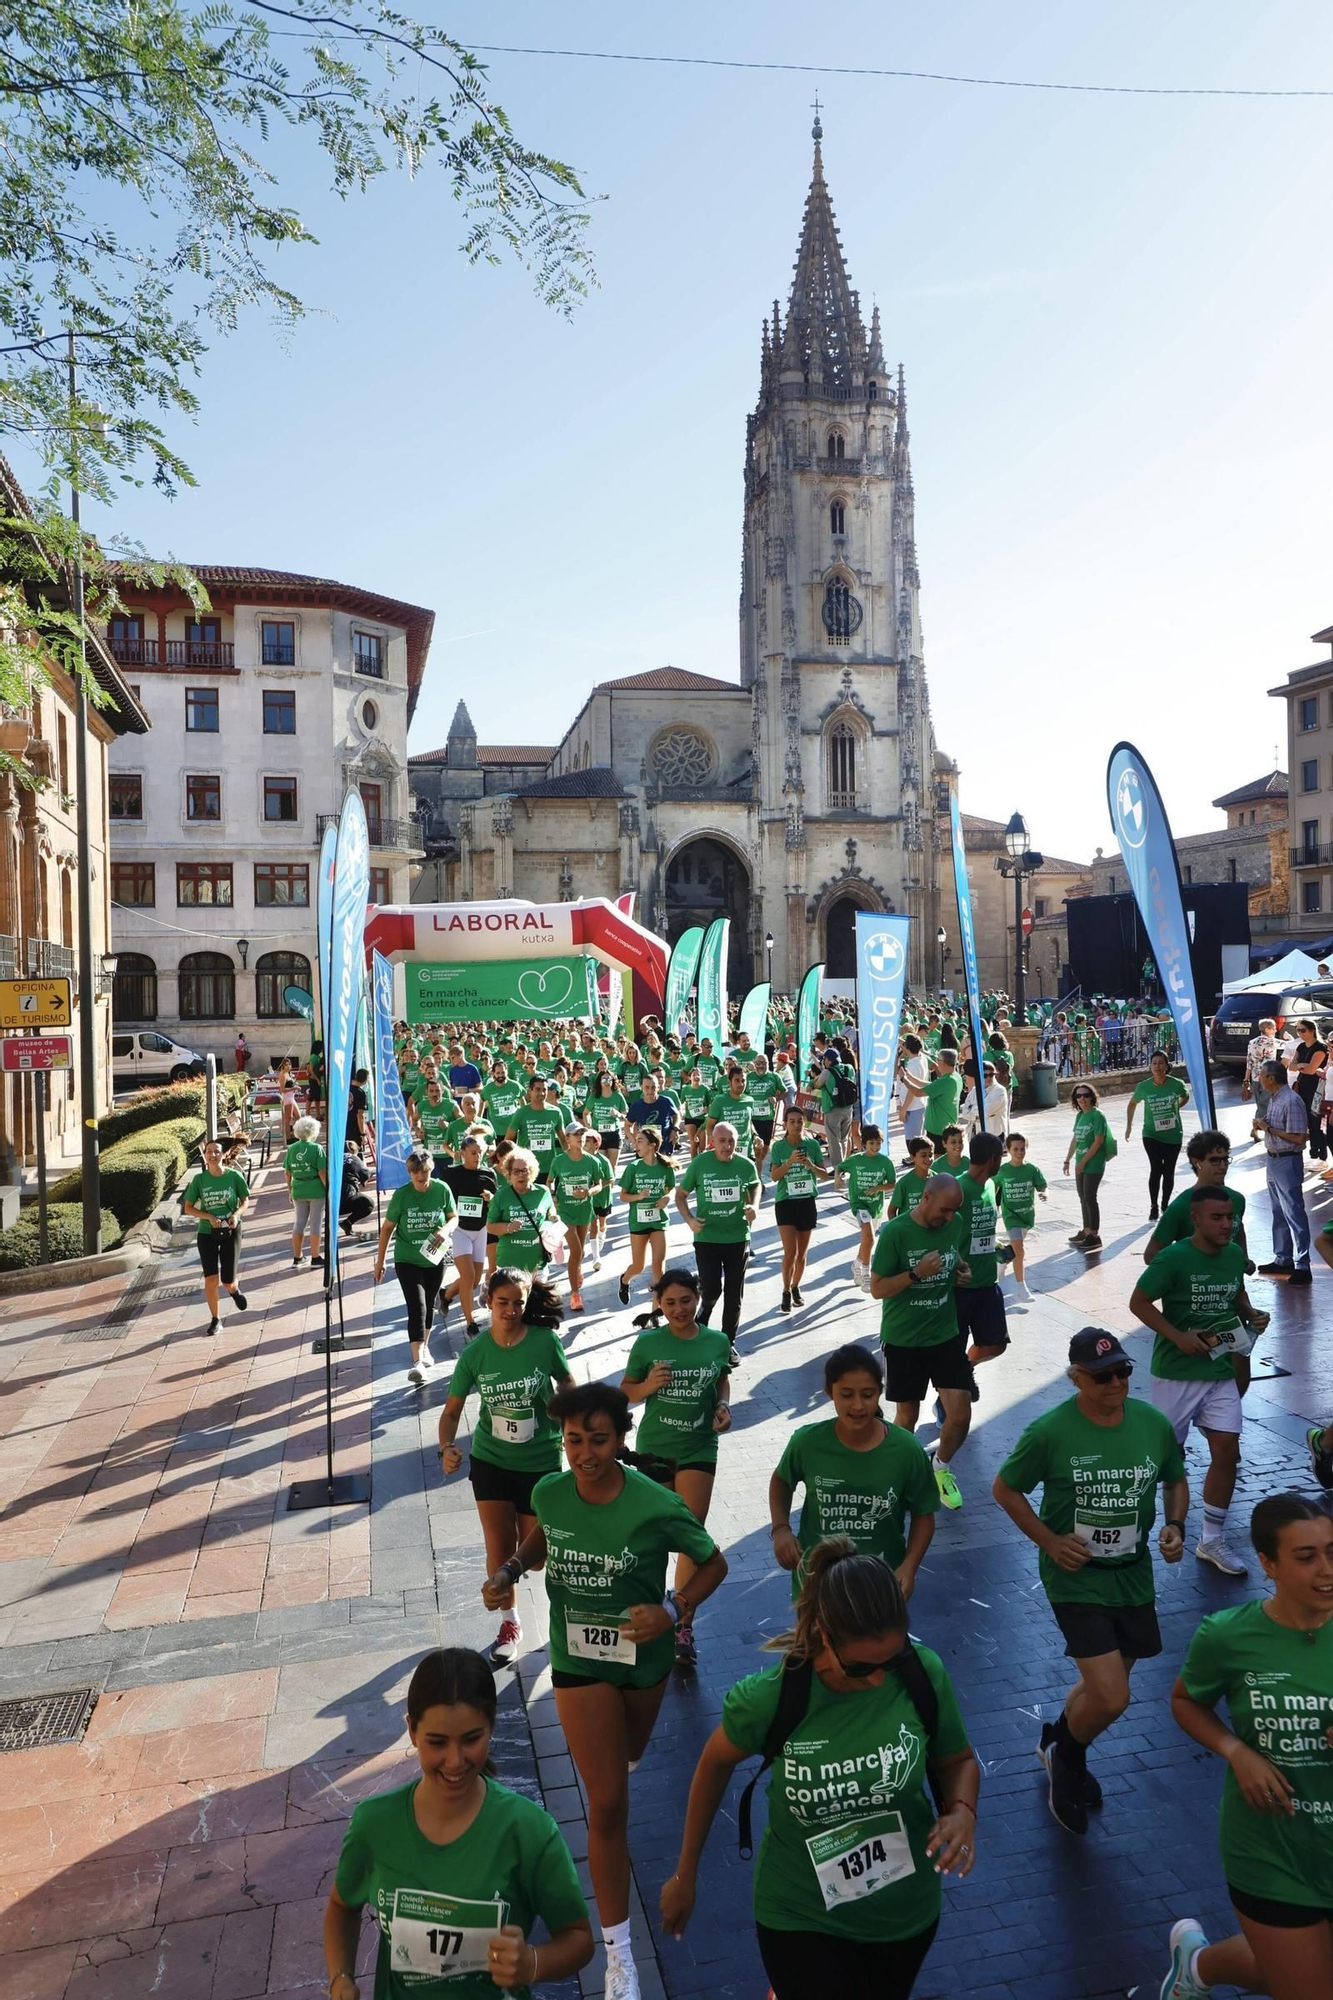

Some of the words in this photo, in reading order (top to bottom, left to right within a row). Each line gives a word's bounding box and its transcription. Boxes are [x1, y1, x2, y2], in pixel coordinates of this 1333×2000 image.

[432, 911, 555, 932] LABORAL
[521, 933, 555, 944] kutxa
[604, 928, 618, 941] banca
[617, 938, 642, 956] cooperativa
[869, 935, 899, 949] BMW
[13, 983, 55, 992] OFICINA
[420, 989, 434, 998] En
[436, 988, 478, 998] marcha
[334, 913, 354, 1091] Autosa
[420, 999, 455, 1008] contra
[458, 998, 469, 1008] el
[471, 997, 509, 1007] cáncer
[4, 1016, 17, 1024] DE
[22, 1014, 66, 1023] TURISMO
[380, 1034, 407, 1163] Autosa
[719, 1188, 733, 1196] 1116
[979, 1238, 990, 1247] 331
[1191, 1283, 1205, 1292] En
[672, 1367, 713, 1377] marcha
[481, 1384, 493, 1394] En
[496, 1377, 538, 1392] marcha
[667, 1387, 702, 1397] cáncer
[505, 1420, 518, 1433] 75
[660, 1416, 692, 1427] LABORAL
[1073, 1469, 1093, 1482] En
[1097, 1466, 1151, 1480] marcha
[1075, 1482, 1121, 1494] contra
[835, 1493, 889, 1509] marcha
[1075, 1495, 1087, 1506] el
[1091, 1495, 1140, 1508] cáncer
[819, 1505, 857, 1517] ontra
[829, 1518, 877, 1531] cáncer
[1092, 1529, 1121, 1545] 452
[563, 1547, 624, 1570] marcha
[562, 1573, 614, 1587] cáncer
[582, 1627, 620, 1647] 1287
[1249, 1690, 1277, 1710] En
[1254, 1717, 1321, 1731] contra
[1258, 1732, 1273, 1749] el
[784, 1758, 812, 1782] En
[820, 1746, 907, 1780] marcha
[785, 1780, 860, 1803] contra
[789, 1805, 808, 1818] el
[815, 1793, 895, 1816] cáncer
[813, 1836, 833, 1848] Oviedo
[815, 1843, 834, 1855] contra
[840, 1830, 859, 1844] cáncer
[837, 1839, 887, 1880] 1374
[401, 1894, 425, 1904] Oviedo
[400, 1902, 421, 1911] contra
[430, 1906, 452, 1916] cáncer
[426, 1929, 464, 1956] 177
